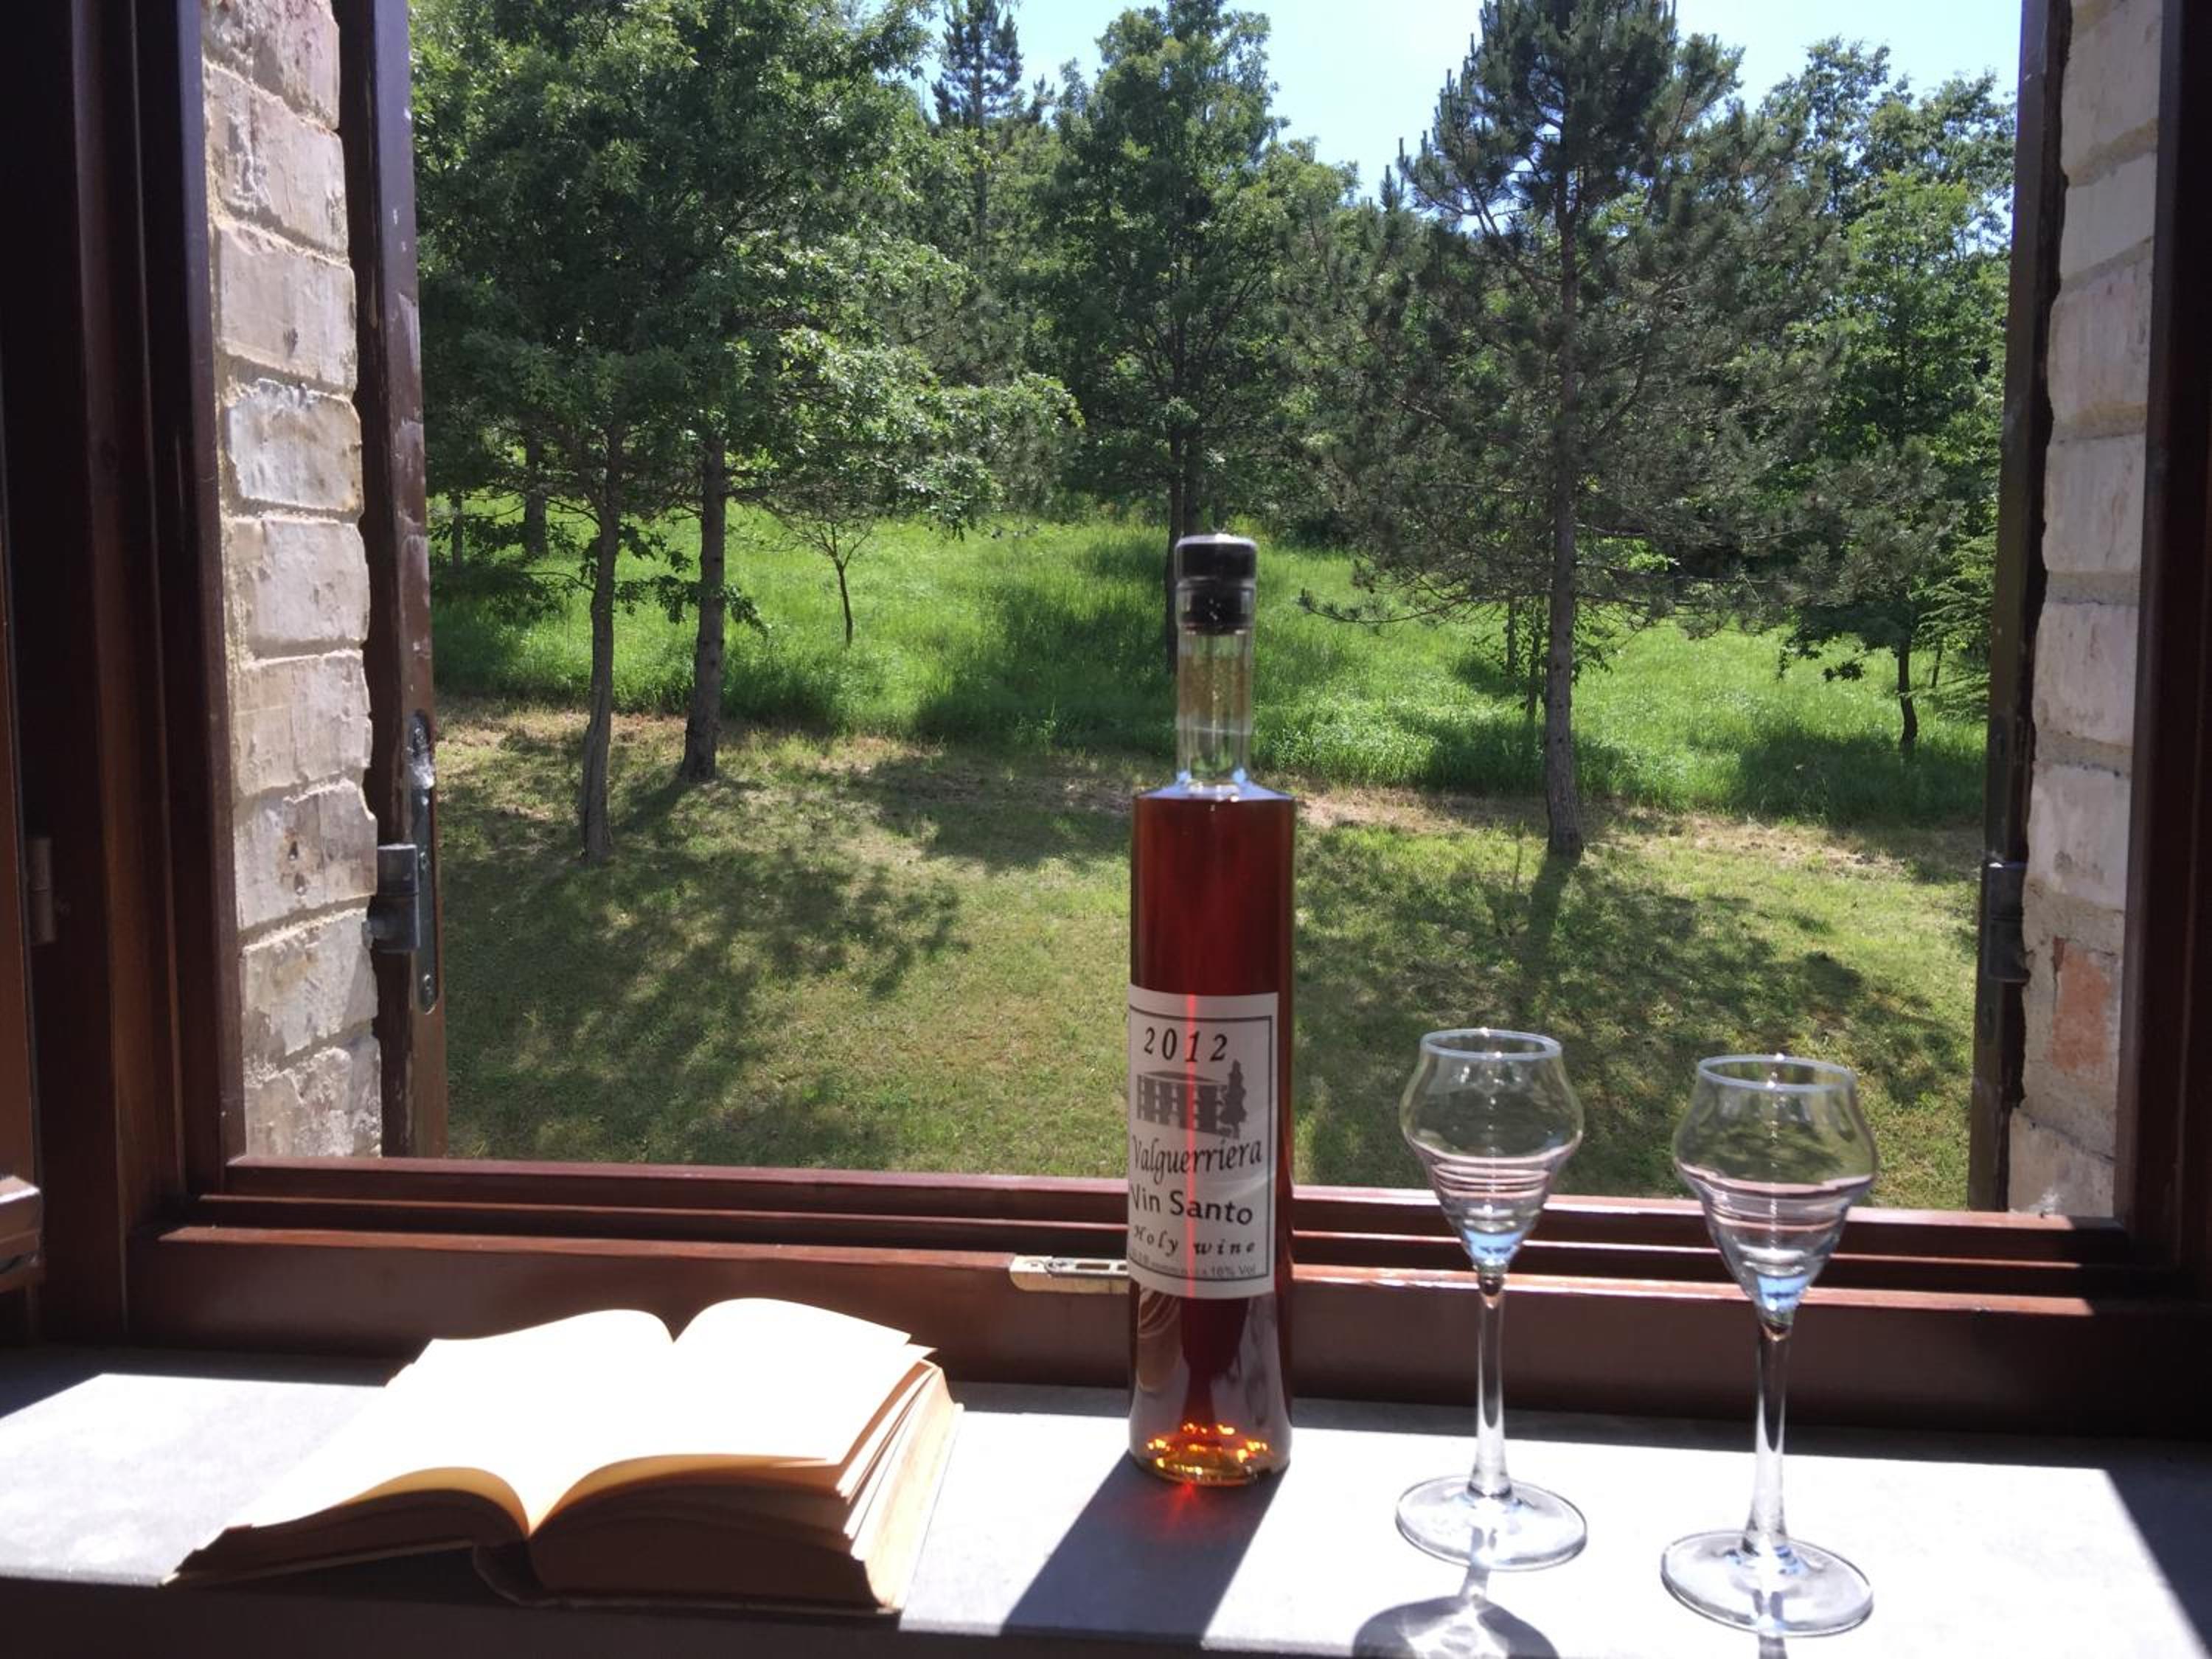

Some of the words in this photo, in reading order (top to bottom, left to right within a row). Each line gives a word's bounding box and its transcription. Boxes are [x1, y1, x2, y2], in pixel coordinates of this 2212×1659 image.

[1144, 1026, 1228, 1062] 2012
[1132, 1135, 1262, 1185] Valguerriera
[1130, 1183, 1161, 1213] Vin
[1170, 1191, 1253, 1225] Santo
[1133, 1224, 1179, 1257] Holy
[1192, 1239, 1256, 1256] wine
